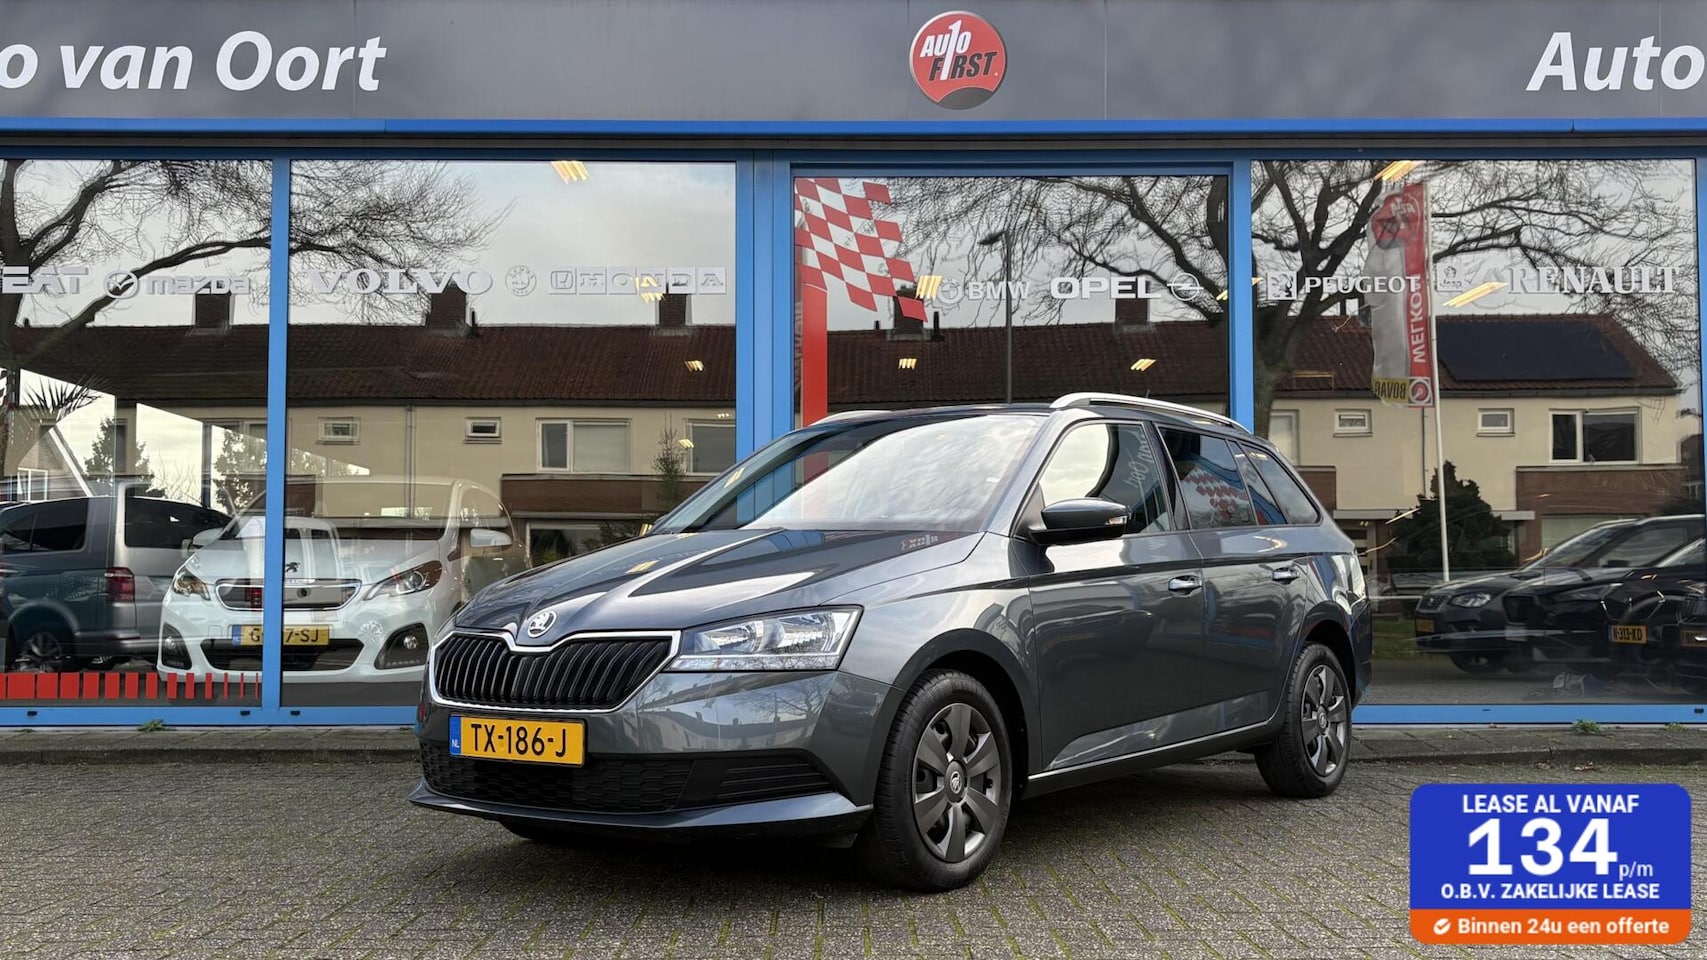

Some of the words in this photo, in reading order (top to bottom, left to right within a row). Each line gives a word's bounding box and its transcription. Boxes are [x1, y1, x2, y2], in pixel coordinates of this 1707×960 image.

[60, 45, 193, 89] van
[216, 30, 387, 91] Oort
[1525, 31, 1706, 91] Auto
[306, 267, 493, 295] VOLVO
[578, 271, 725, 290] HONDA
[967, 280, 1030, 300] BMW
[1050, 277, 1161, 299] OPEL
[1304, 275, 1421, 294] PEUGEOT
[1508, 266, 1681, 295] RENAULT
[470, 723, 567, 758] TX-186-J
